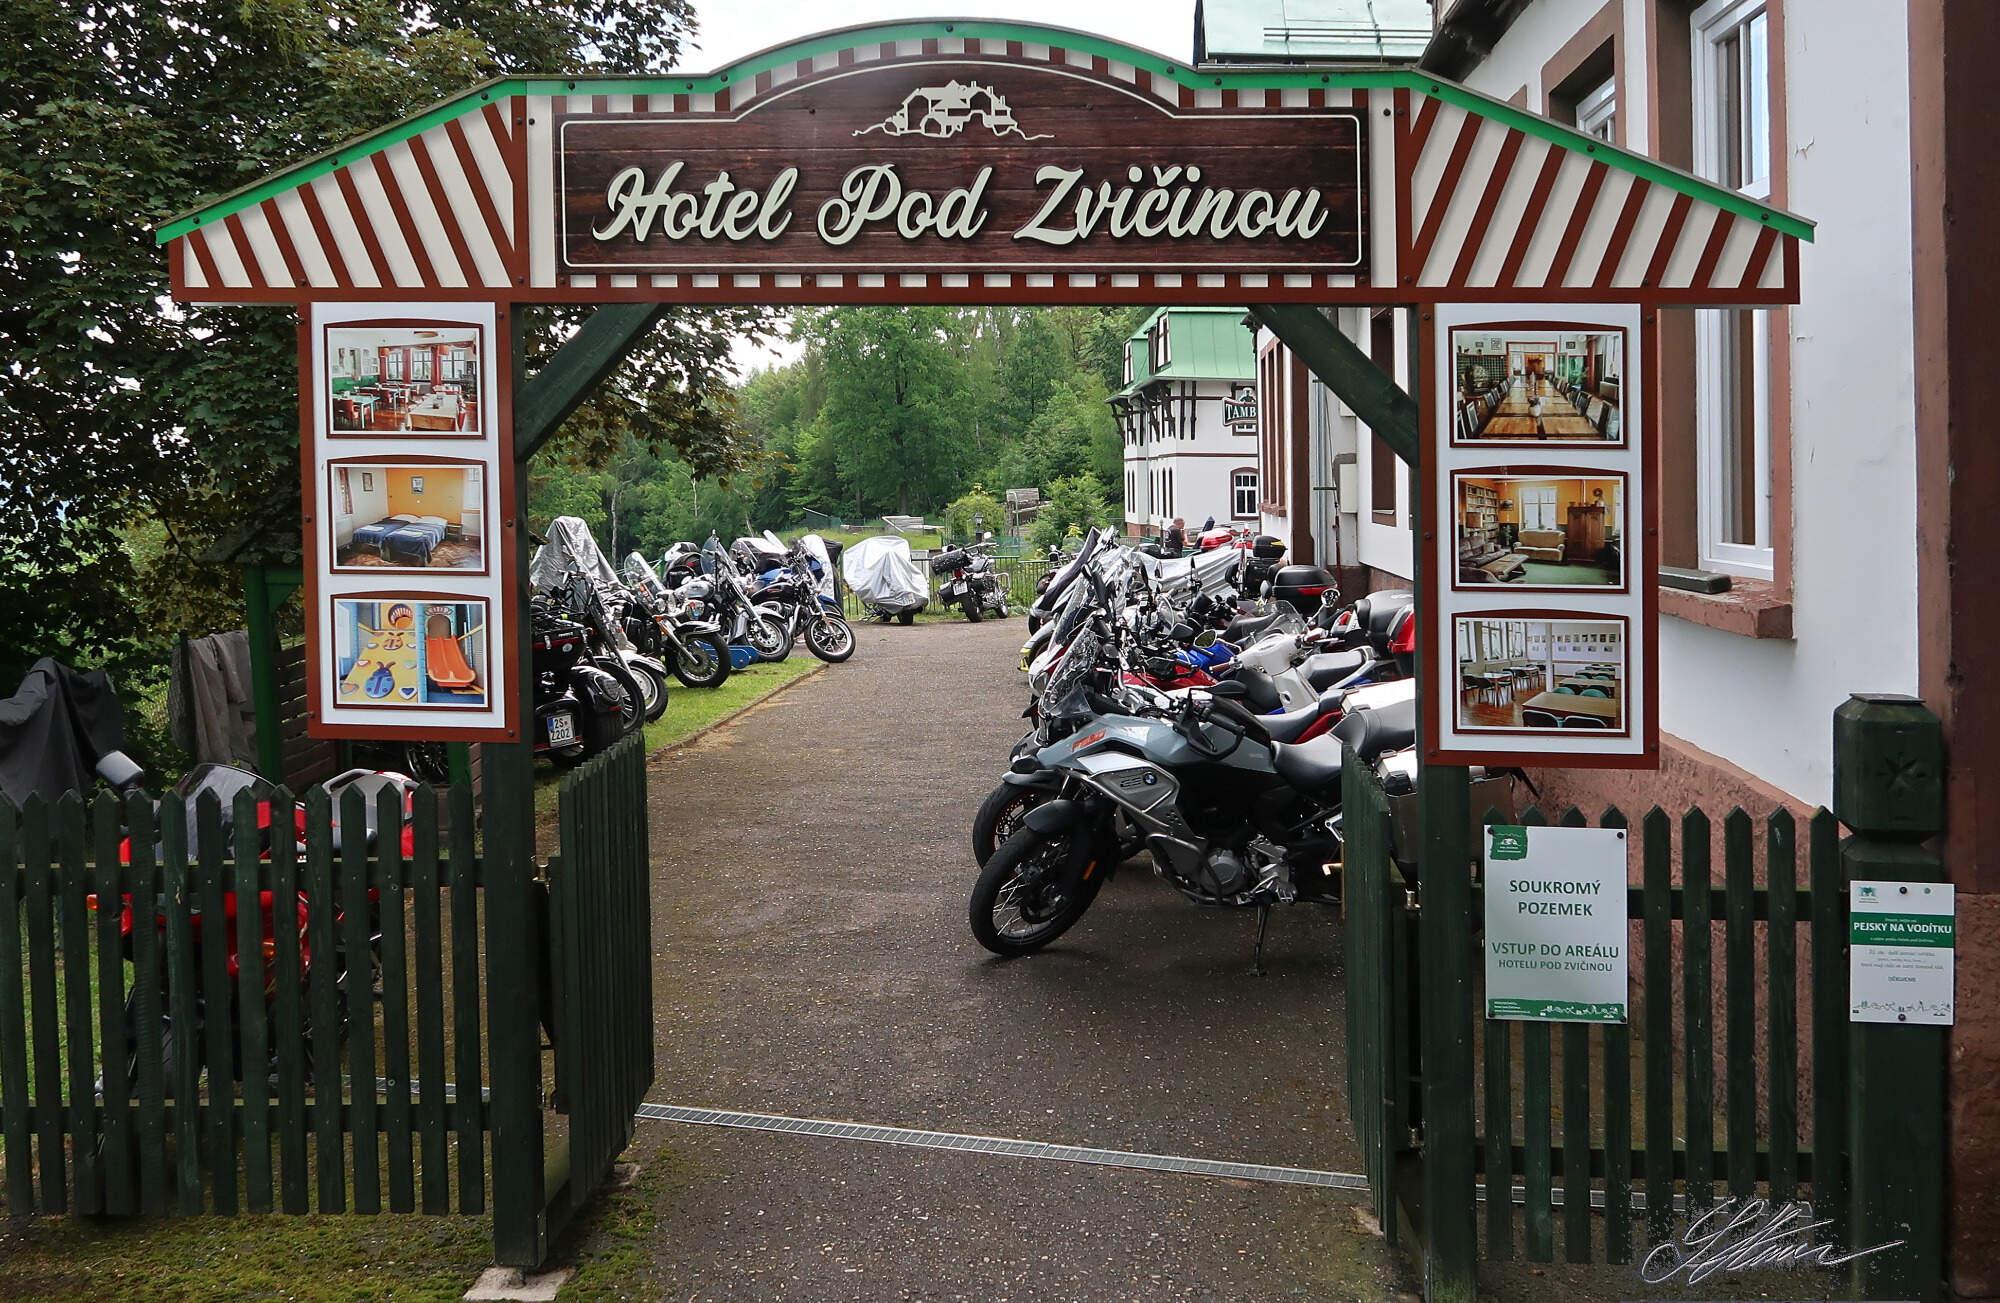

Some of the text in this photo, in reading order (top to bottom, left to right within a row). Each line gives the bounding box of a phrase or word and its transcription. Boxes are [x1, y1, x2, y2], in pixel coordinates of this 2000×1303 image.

[592, 161, 1329, 247] Hotel Pod Zvičinou
[1509, 879, 1601, 895] SOUKROMÝ
[1518, 901, 1593, 917] POZEMEK
[1853, 922, 1952, 934] PEJSKY NA VODÍTKU
[1491, 942, 1619, 959] VSTUP DO AREÁLU
[1498, 959, 1613, 972] HOTELU POD ZVIČINOU
